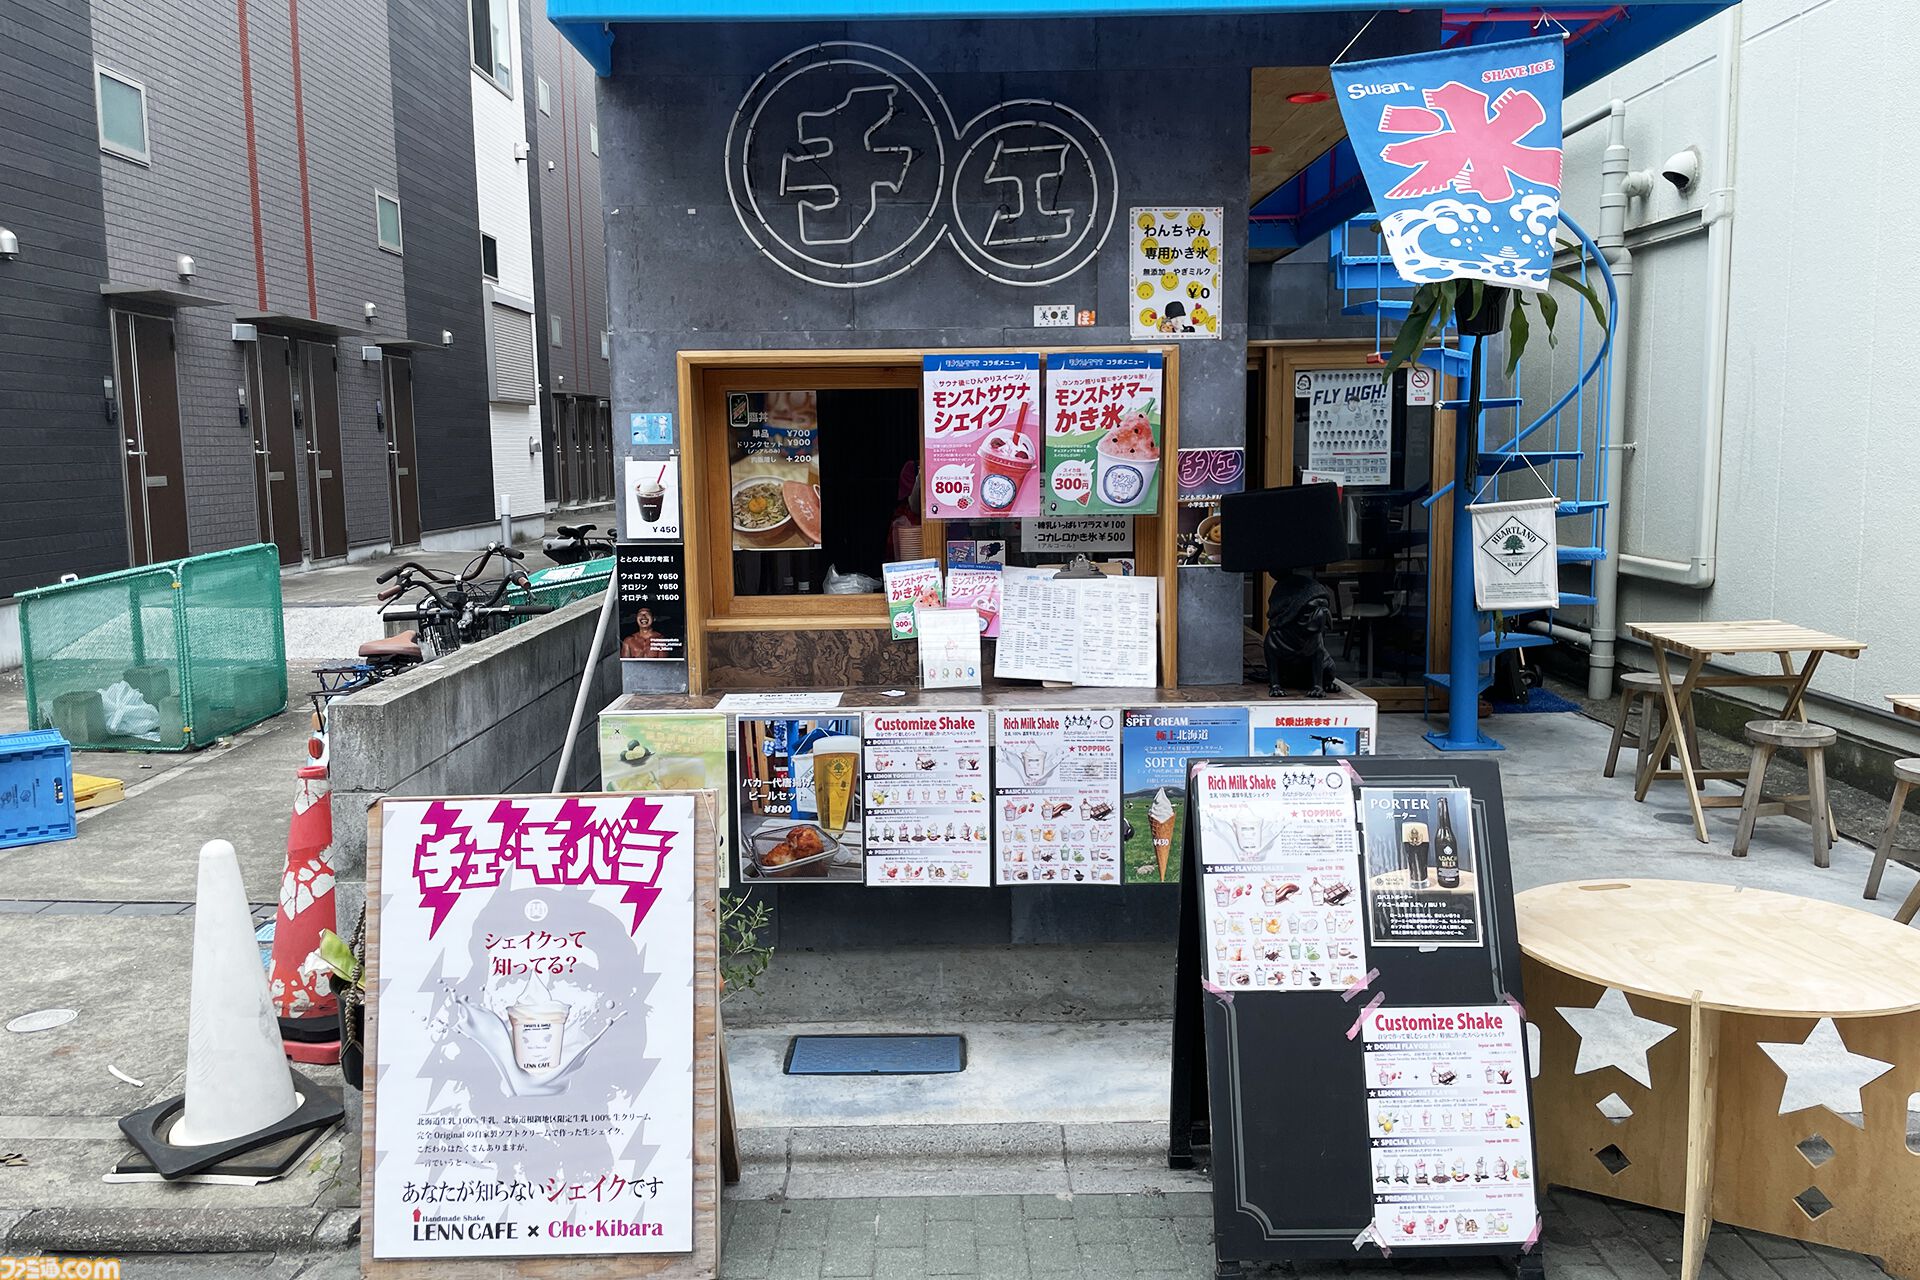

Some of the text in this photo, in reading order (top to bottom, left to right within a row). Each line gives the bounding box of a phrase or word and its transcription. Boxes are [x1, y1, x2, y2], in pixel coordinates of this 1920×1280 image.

[1482, 59, 1555, 83] SHAVE ICE
[1144, 224, 1211, 238] わんちゃん
[1145, 246, 1209, 260] 専用かき氷
[1143, 268, 1211, 276] 無添加 やぎミルク
[933, 382, 1030, 408] モンストサウナ
[1055, 382, 1153, 406] モンストサマー
[1313, 383, 1388, 406] FLY HIGH!
[934, 403, 1007, 433] シェイク
[1054, 402, 1125, 432] かき氷
[752, 429, 811, 438] 単品 ¥700
[737, 438, 811, 449] ドリンクセット ¥900
[1491, 526, 1537, 545] HEARTLAND
[620, 572, 654, 580] ウォロッカ
[890, 574, 937, 588] モンストサマー
[952, 576, 998, 586] モンストサウナ
[621, 583, 648, 591] オロジン
[892, 585, 924, 601] かき氷
[951, 585, 986, 596] シェイク
[621, 594, 649, 602] オロテキ
[874, 716, 975, 730] Customize Shake
[1003, 717, 1019, 729] Rich
[1020, 717, 1036, 729] Milk
[1037, 717, 1060, 729] Shake
[1154, 717, 1188, 726] CREAM
[1145, 757, 1176, 768] SOFT
[1207, 775, 1227, 790] Rich
[1229, 775, 1248, 790] Milk
[1250, 774, 1277, 790] Shake
[764, 805, 792, 814] ¥800
[1370, 798, 1430, 810] PORTER
[1301, 809, 1343, 817] TOPPING
[1386, 812, 1416, 820] ポーター
[485, 931, 587, 950] シェイクって
[492, 955, 578, 976] 知ってる？
[1375, 1012, 1503, 1031] Customize Shake
[1374, 1043, 1400, 1051] DOUBLE
[417, 1116, 456, 1126] 北海道生乳
[458, 1116, 478, 1125] 100%
[590, 1114, 611, 1122] 100%
[612, 1113, 652, 1121] 生クリーム
[433, 1130, 465, 1141] Original
[402, 1174, 664, 1204] あなたが知らないシェイクです
[413, 1223, 464, 1241] LENN
[468, 1222, 519, 1240] CAFE
